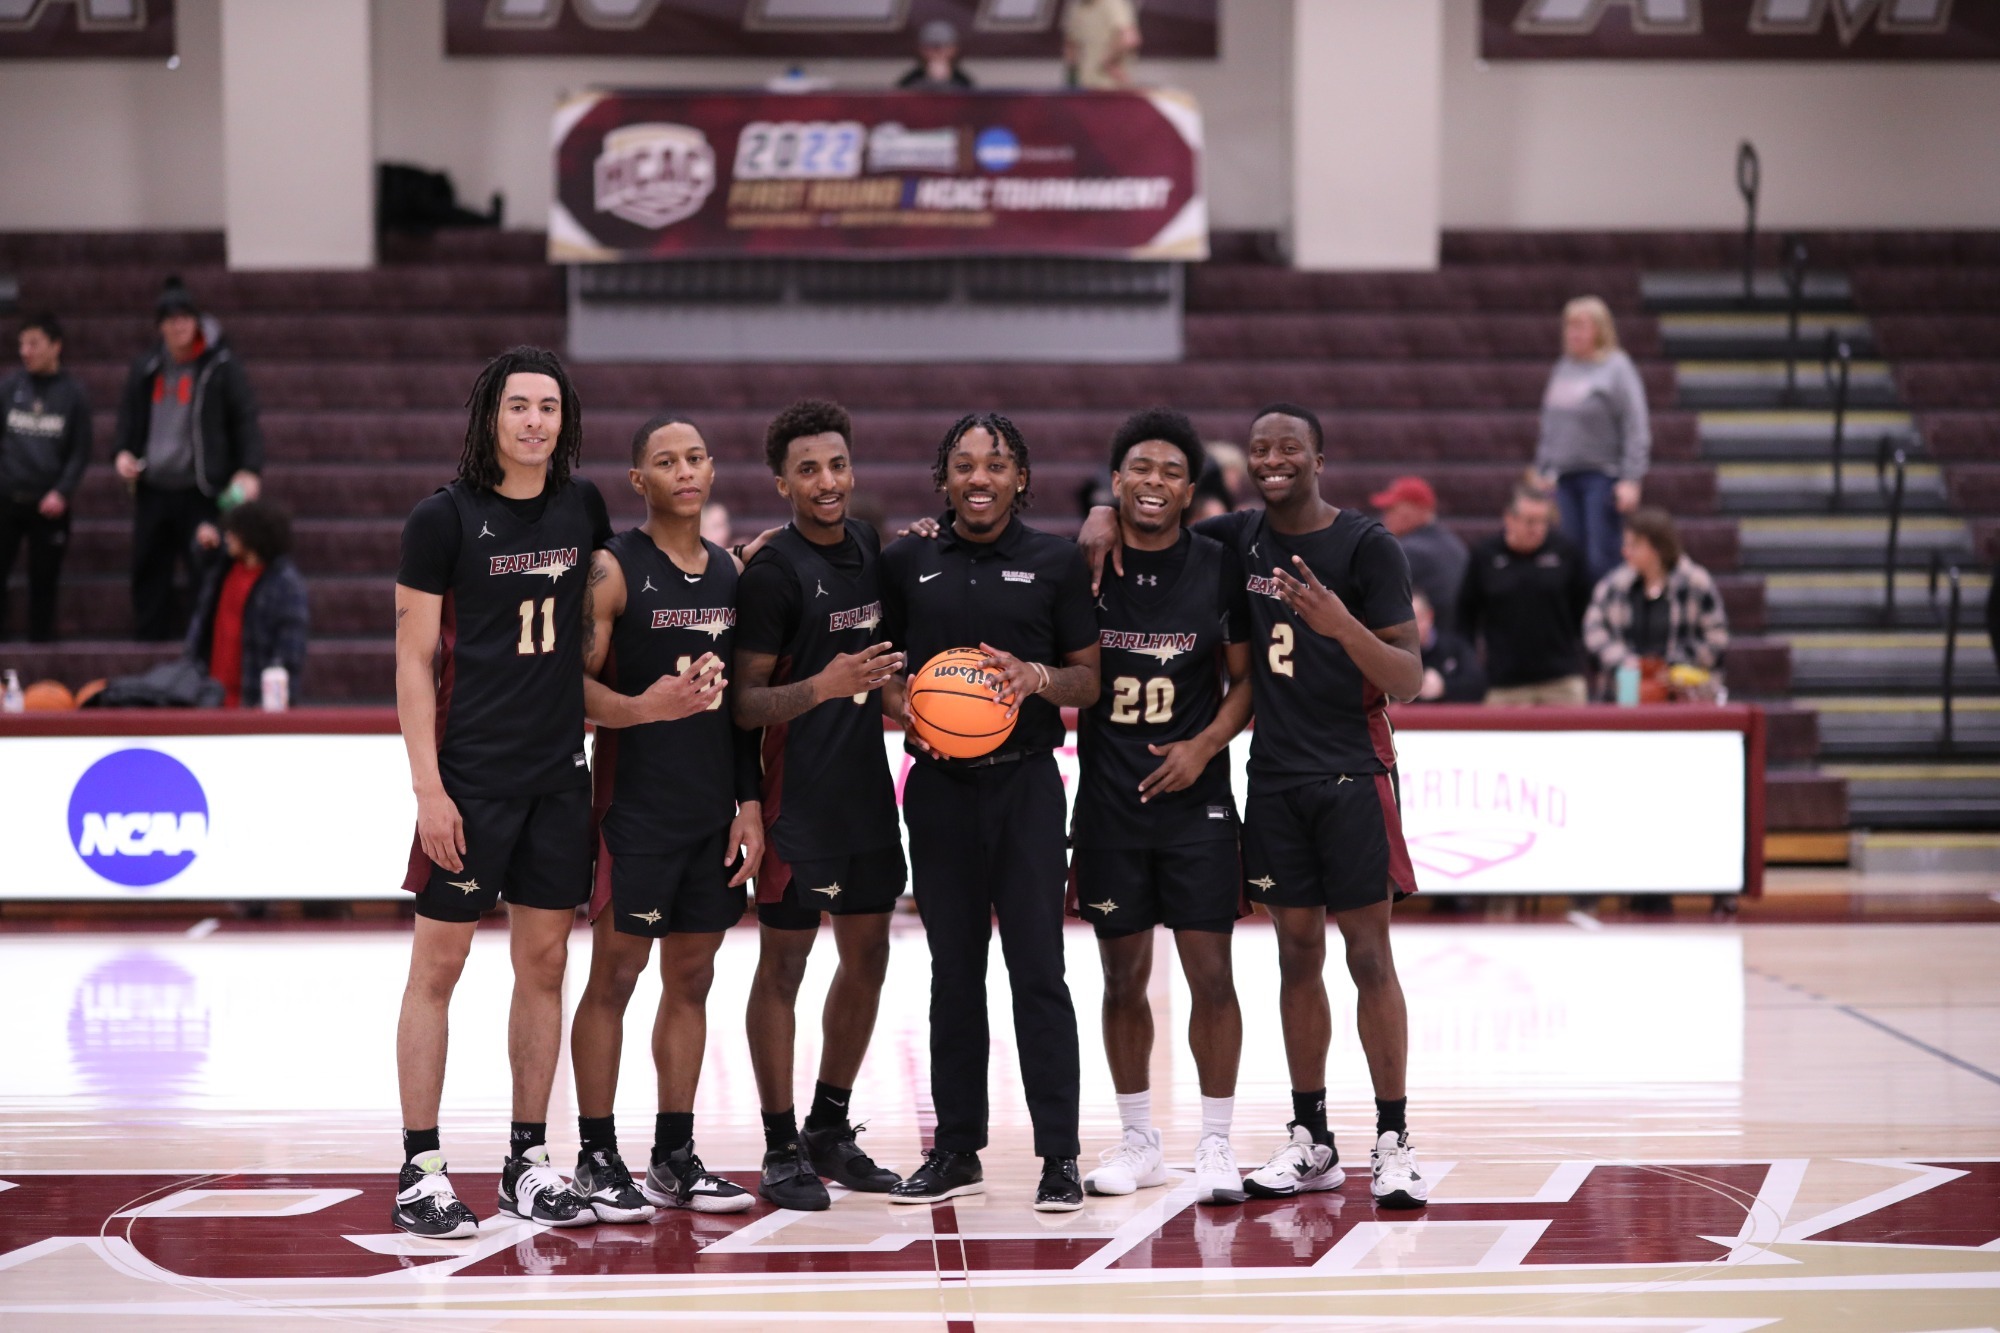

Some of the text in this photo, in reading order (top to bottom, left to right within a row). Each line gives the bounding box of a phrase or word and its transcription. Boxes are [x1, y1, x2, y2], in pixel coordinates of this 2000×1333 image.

[740, 126, 864, 175] 2022
[489, 547, 577, 575] EARLHAM
[516, 596, 556, 656] 11
[651, 607, 736, 629] EARLHAM
[1100, 630, 1197, 652] EARLHAM
[1268, 622, 1294, 678] 2
[1110, 676, 1175, 724] 20
[1401, 768, 1567, 829] ARTLAND
[78, 811, 208, 857] NCAA
